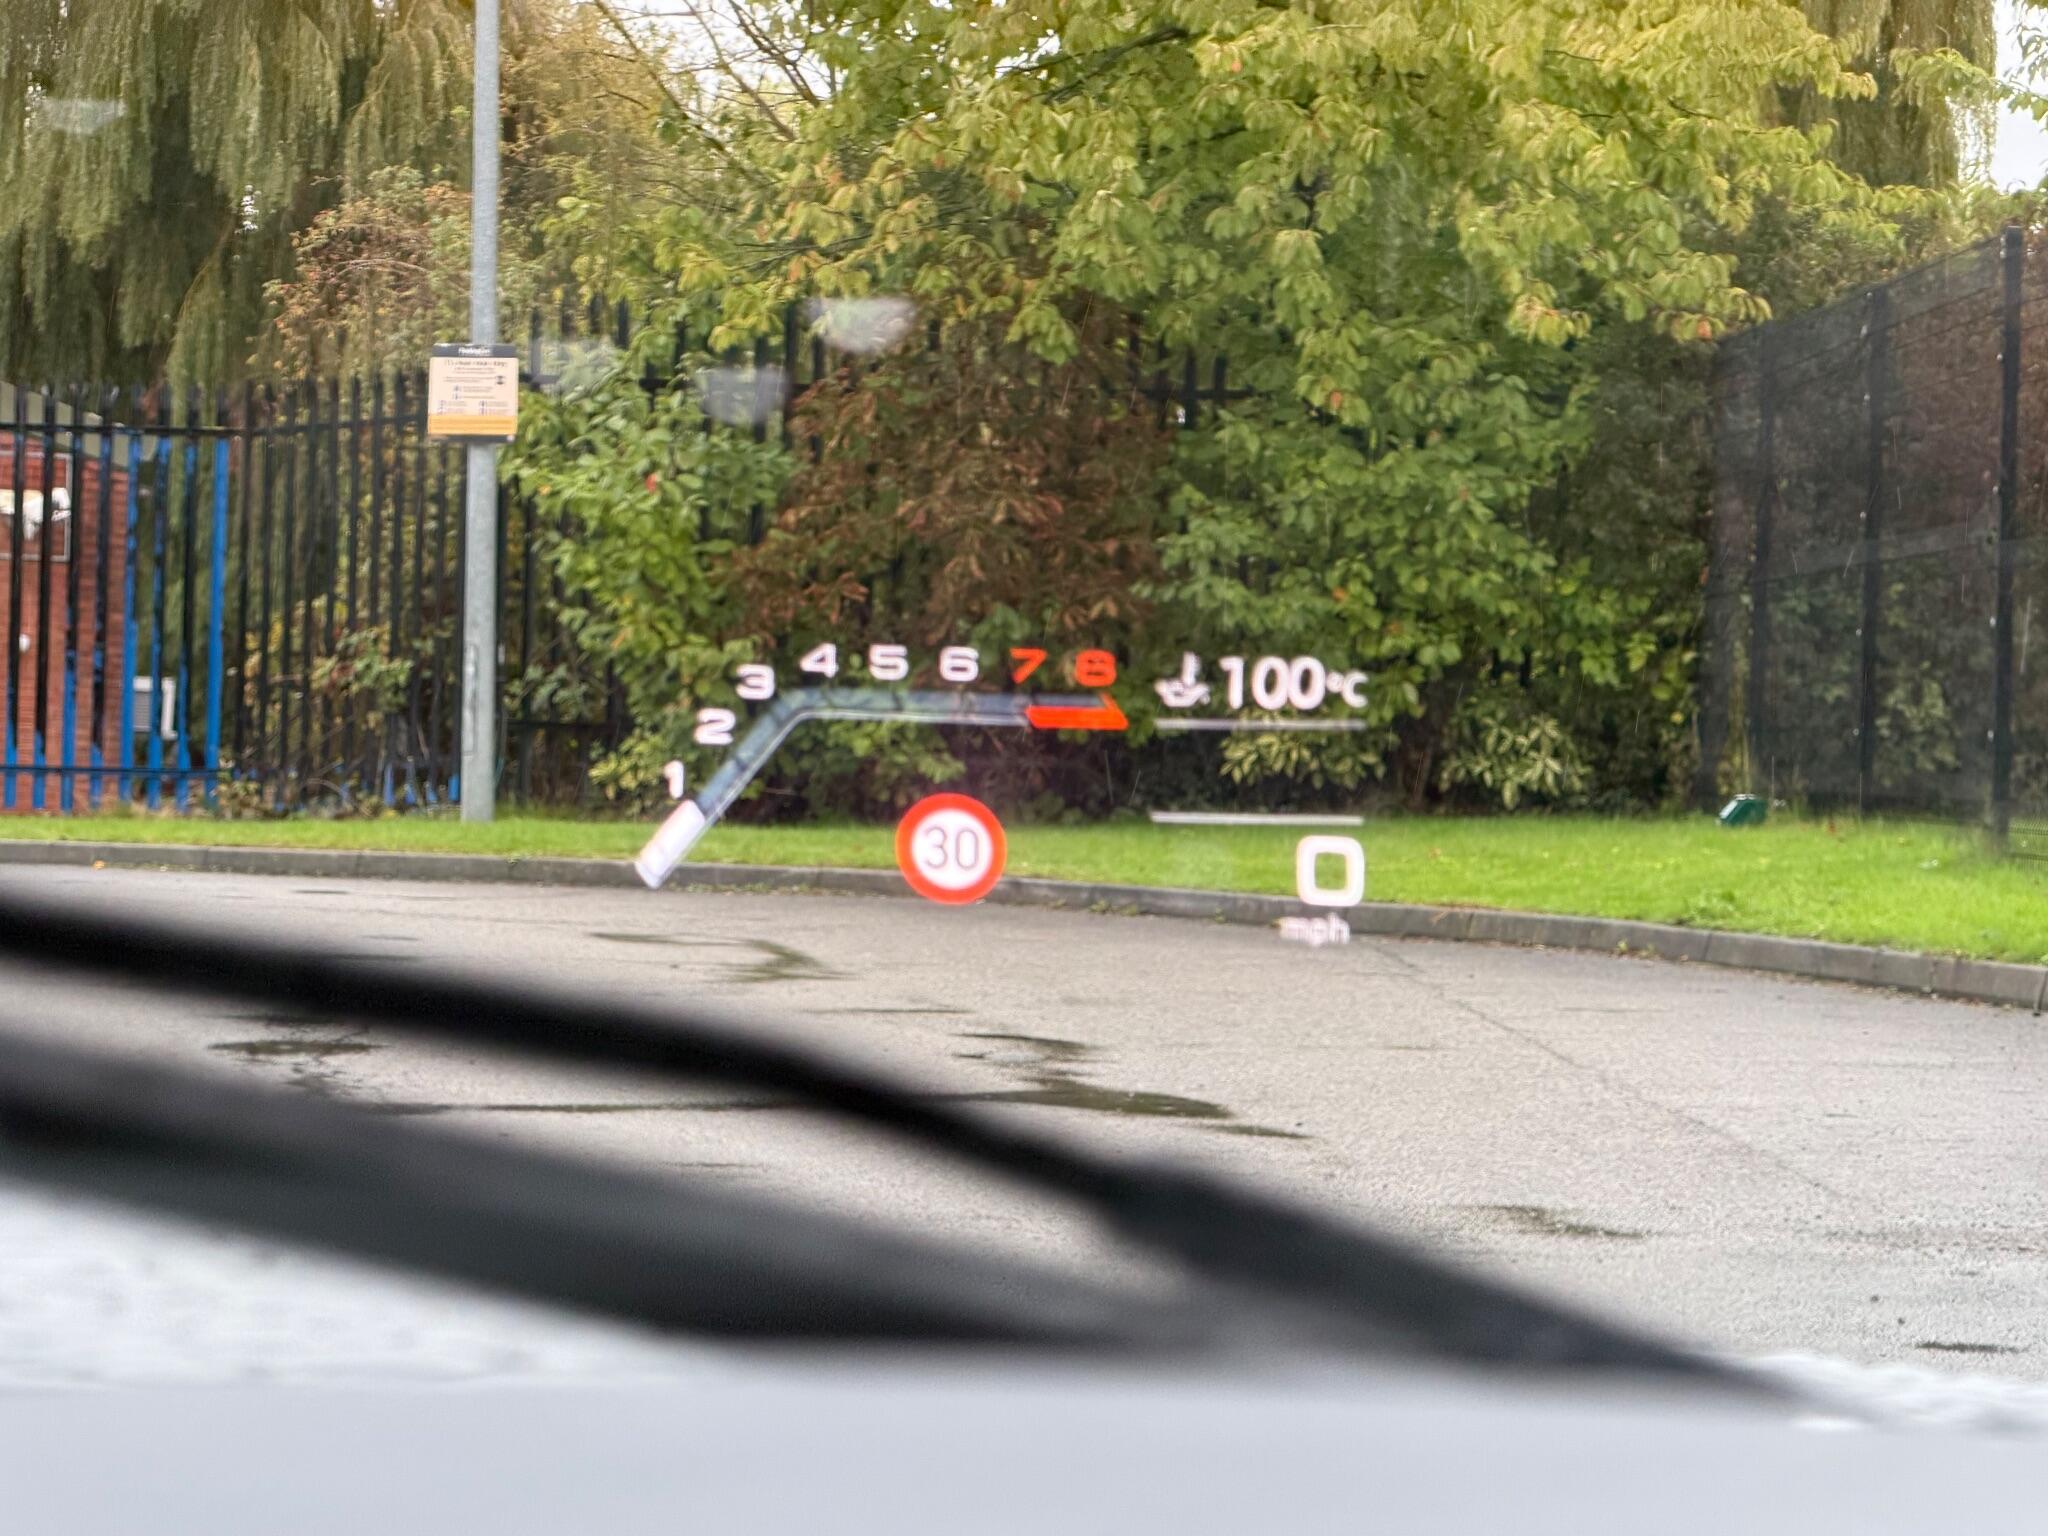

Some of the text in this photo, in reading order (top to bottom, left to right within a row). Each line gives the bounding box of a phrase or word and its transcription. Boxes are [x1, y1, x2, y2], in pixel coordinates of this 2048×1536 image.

[664, 643, 1117, 799] 1 2 3 4 5 6 7 8
[924, 826, 979, 871] 30
[1296, 835, 1365, 906] 0
